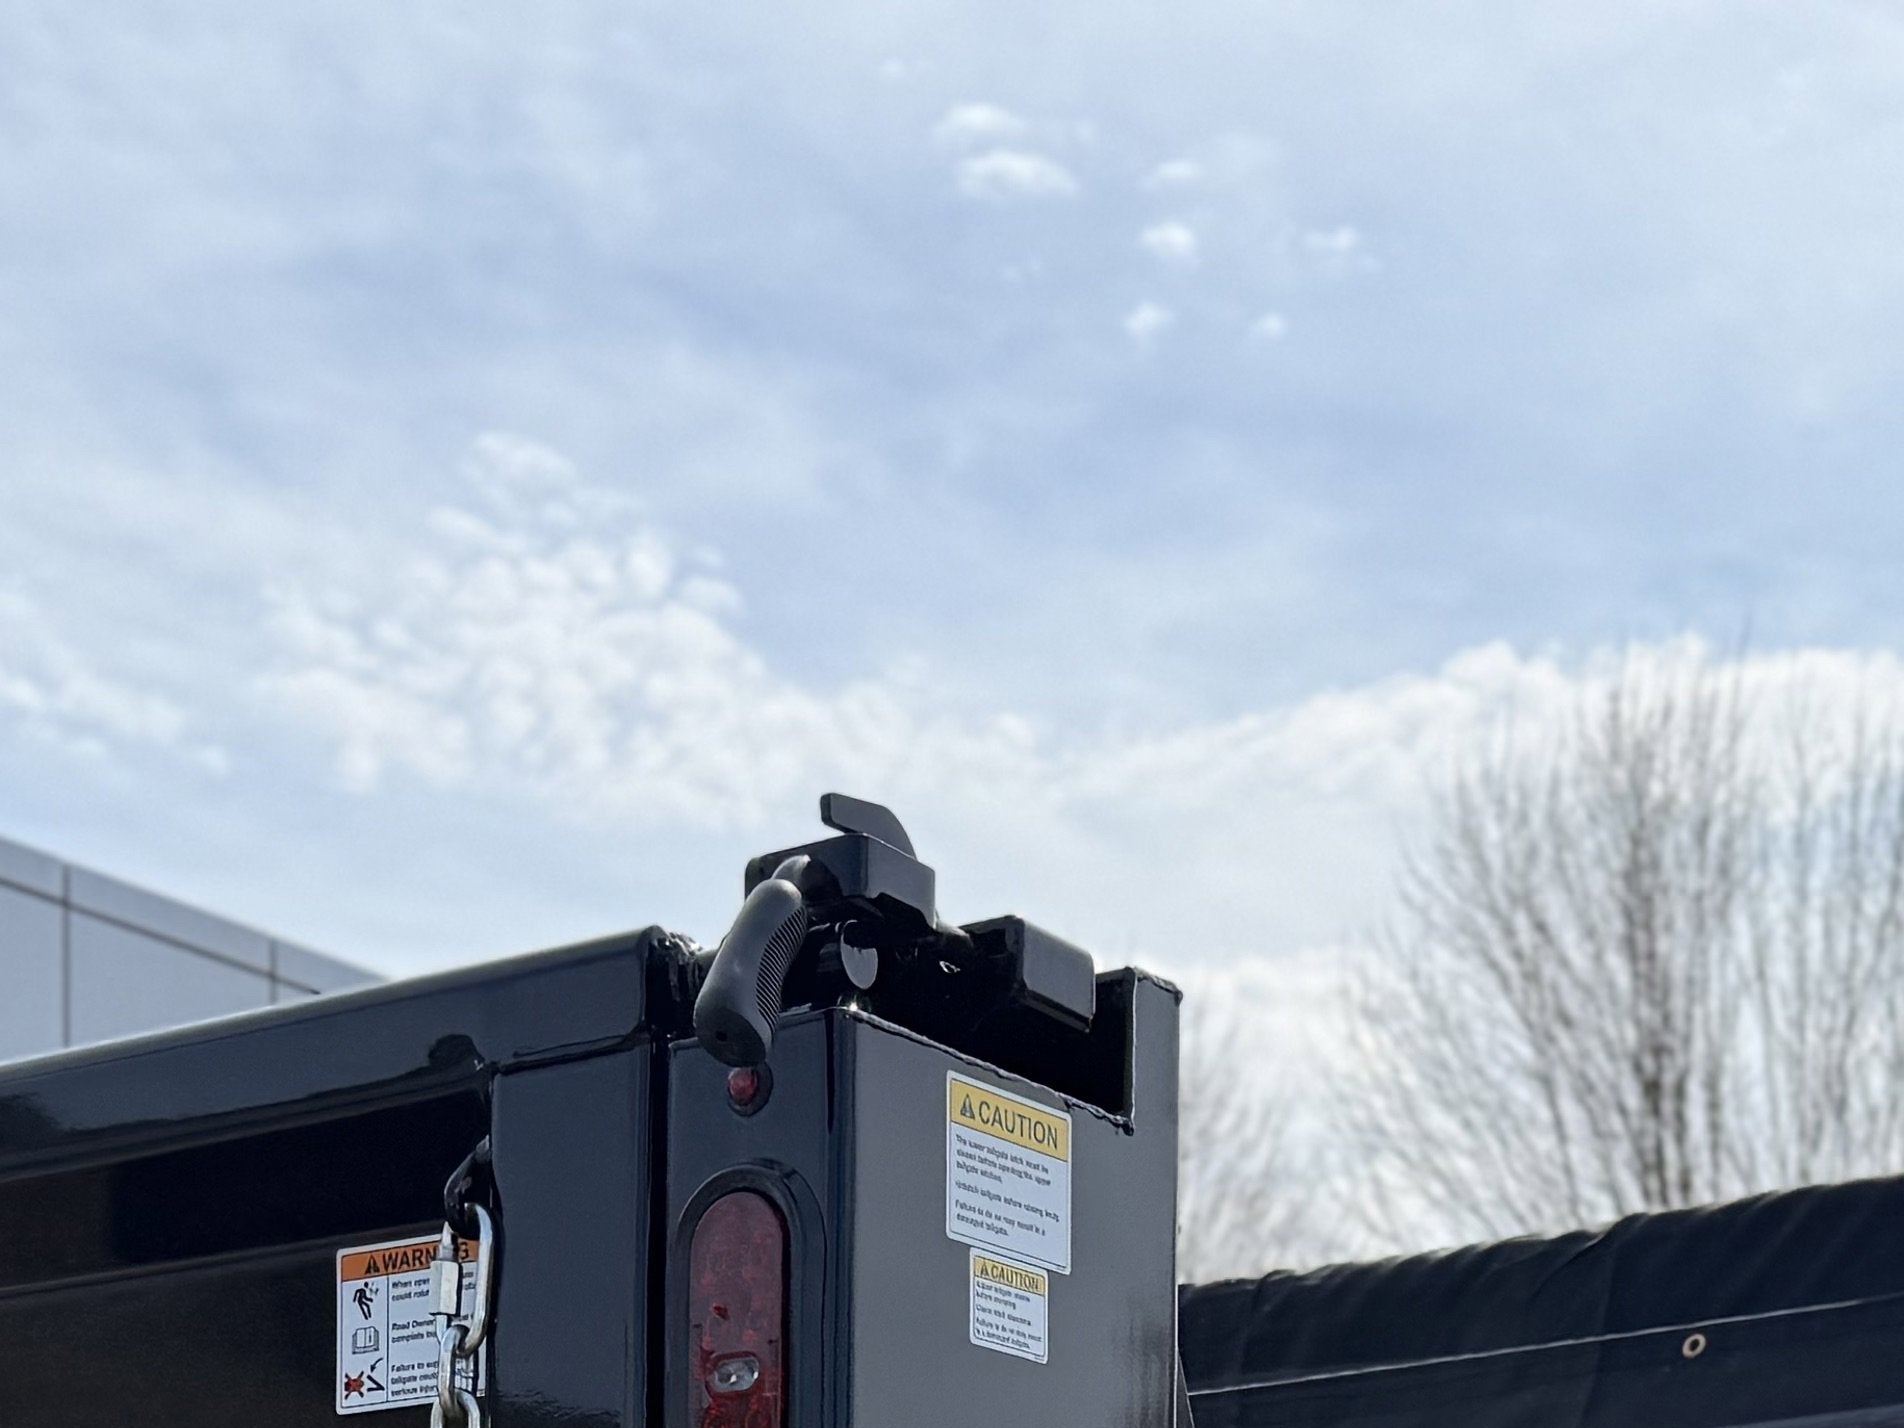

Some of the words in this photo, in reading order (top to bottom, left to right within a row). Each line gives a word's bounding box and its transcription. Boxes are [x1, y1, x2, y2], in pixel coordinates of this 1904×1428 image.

[978, 1100, 1059, 1151] CAUTION
[382, 1241, 470, 1273] WARNG
[990, 1266, 1040, 1292] CAUTION
